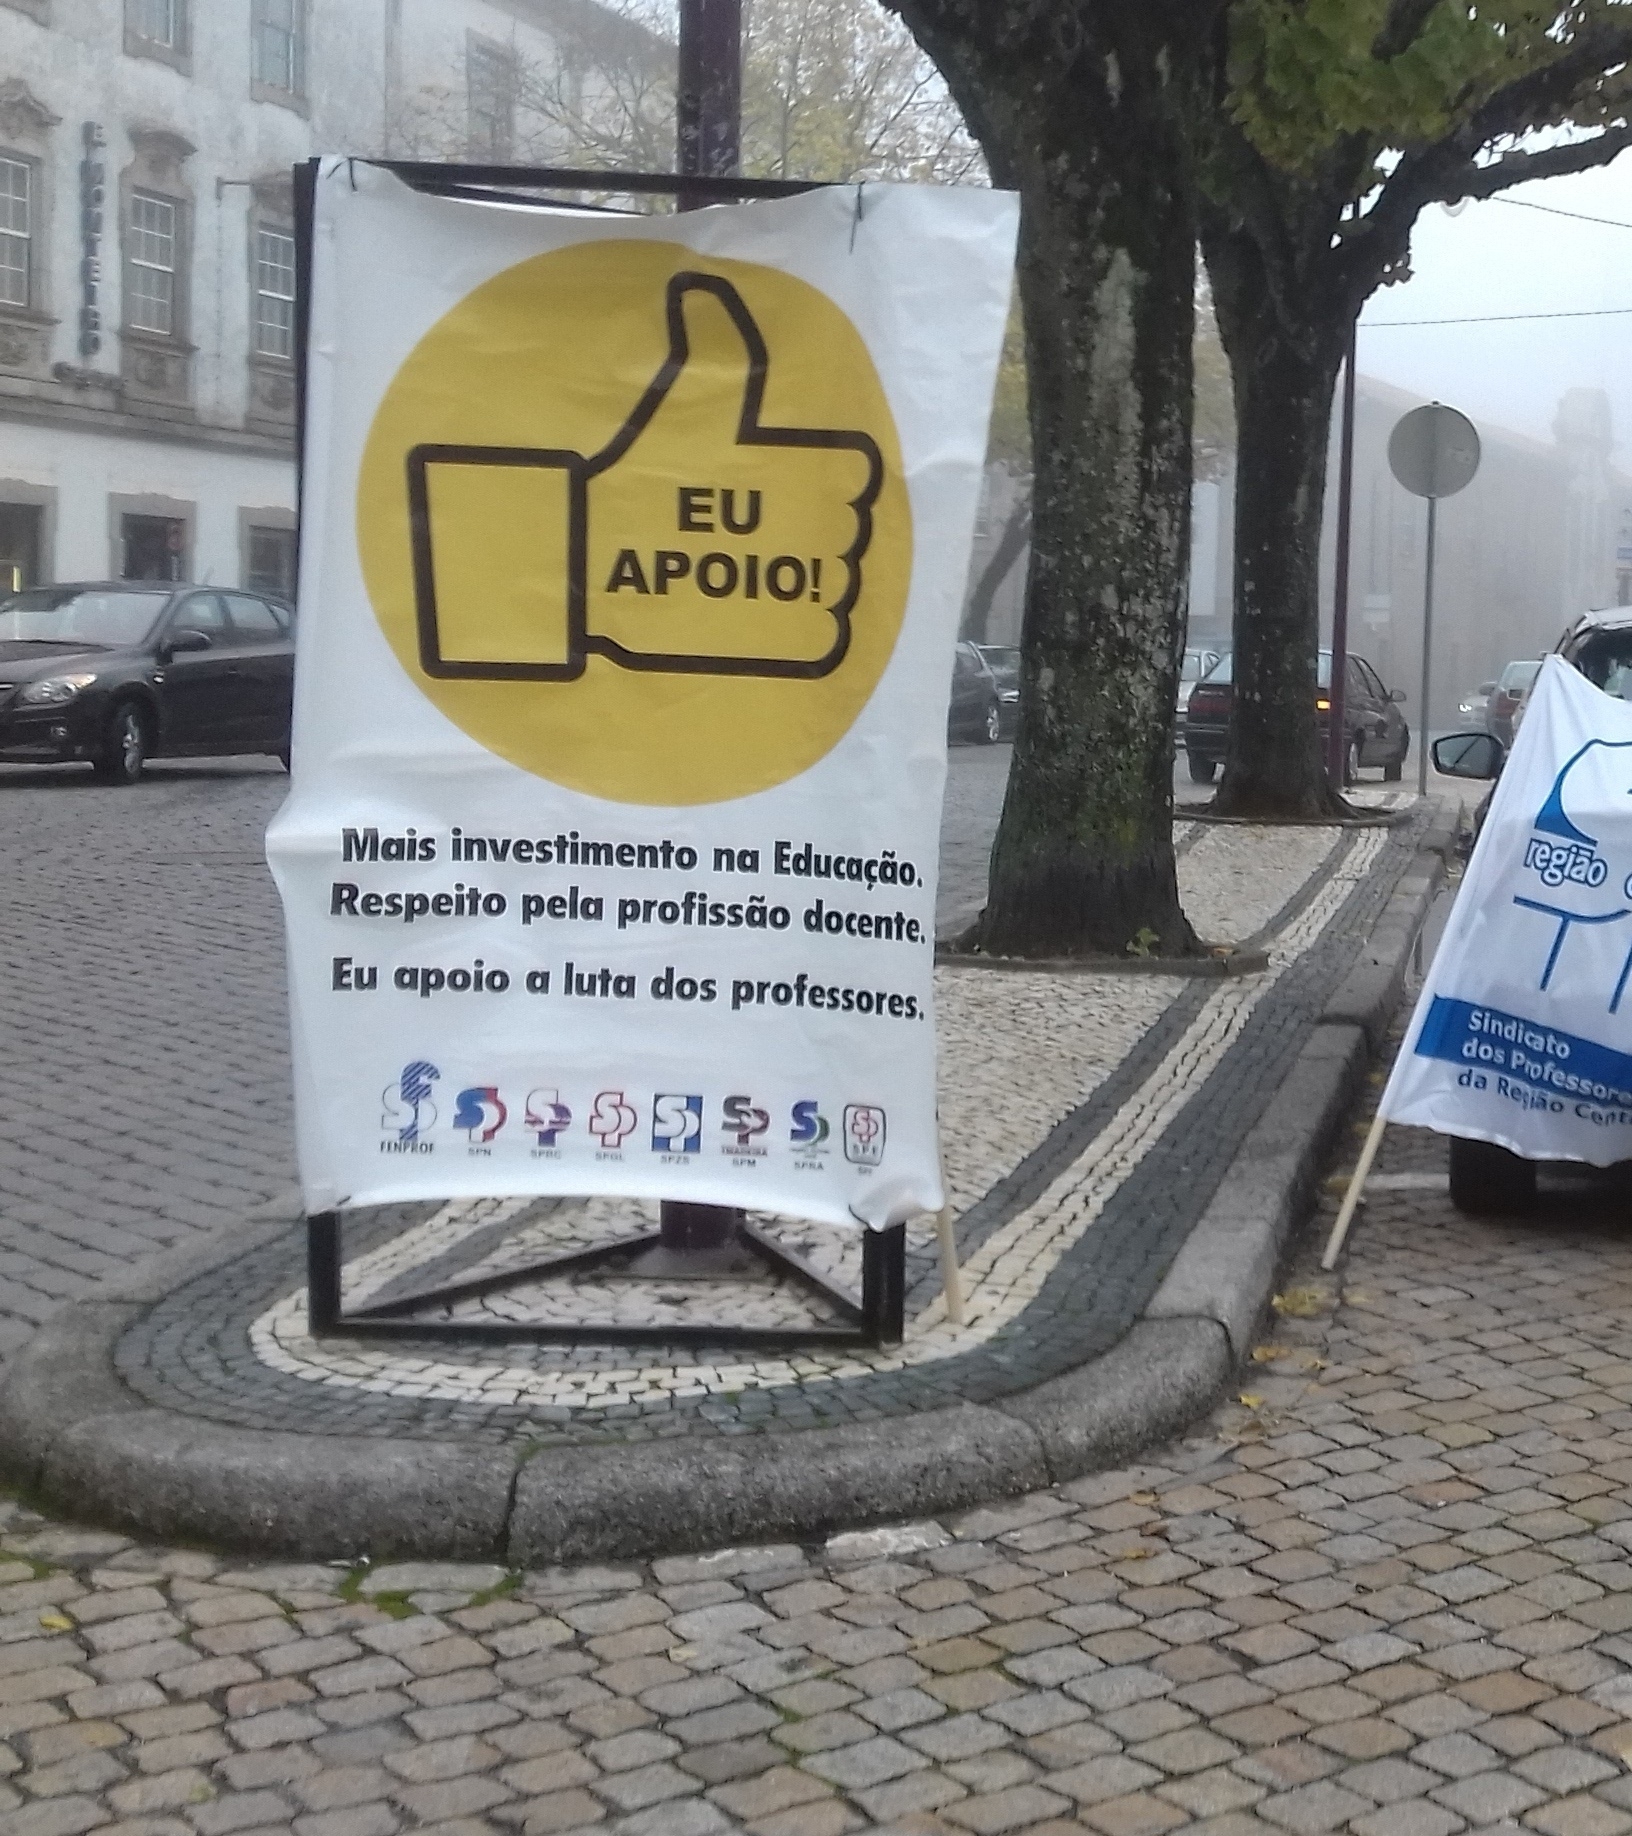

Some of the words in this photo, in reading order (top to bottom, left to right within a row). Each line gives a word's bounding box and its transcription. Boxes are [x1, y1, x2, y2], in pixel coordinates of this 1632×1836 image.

[677, 486, 762, 535] EU
[605, 548, 822, 604] APOIO!
[341, 827, 437, 864] Mais
[450, 828, 698, 871] investimento
[712, 846, 760, 873] na
[773, 841, 925, 891] Educação.
[1523, 837, 1608, 887] região
[330, 882, 507, 923] Respeito
[521, 886, 603, 925] pela
[617, 890, 791, 931] profissão
[803, 899, 927, 944] docente.
[332, 957, 377, 992] Eu
[394, 959, 510, 998] apoio
[526, 972, 550, 995] a
[564, 962, 636, 999] luta
[651, 967, 717, 1002] dos
[731, 974, 926, 1021] professores.
[1461, 1037, 1506, 1065] dos
[1467, 1009, 1571, 1060] Sindicato
[1457, 1068, 1487, 1090] da
[1497, 1076, 1564, 1113] Região
[380, 1140, 434, 1154] FENPROF
